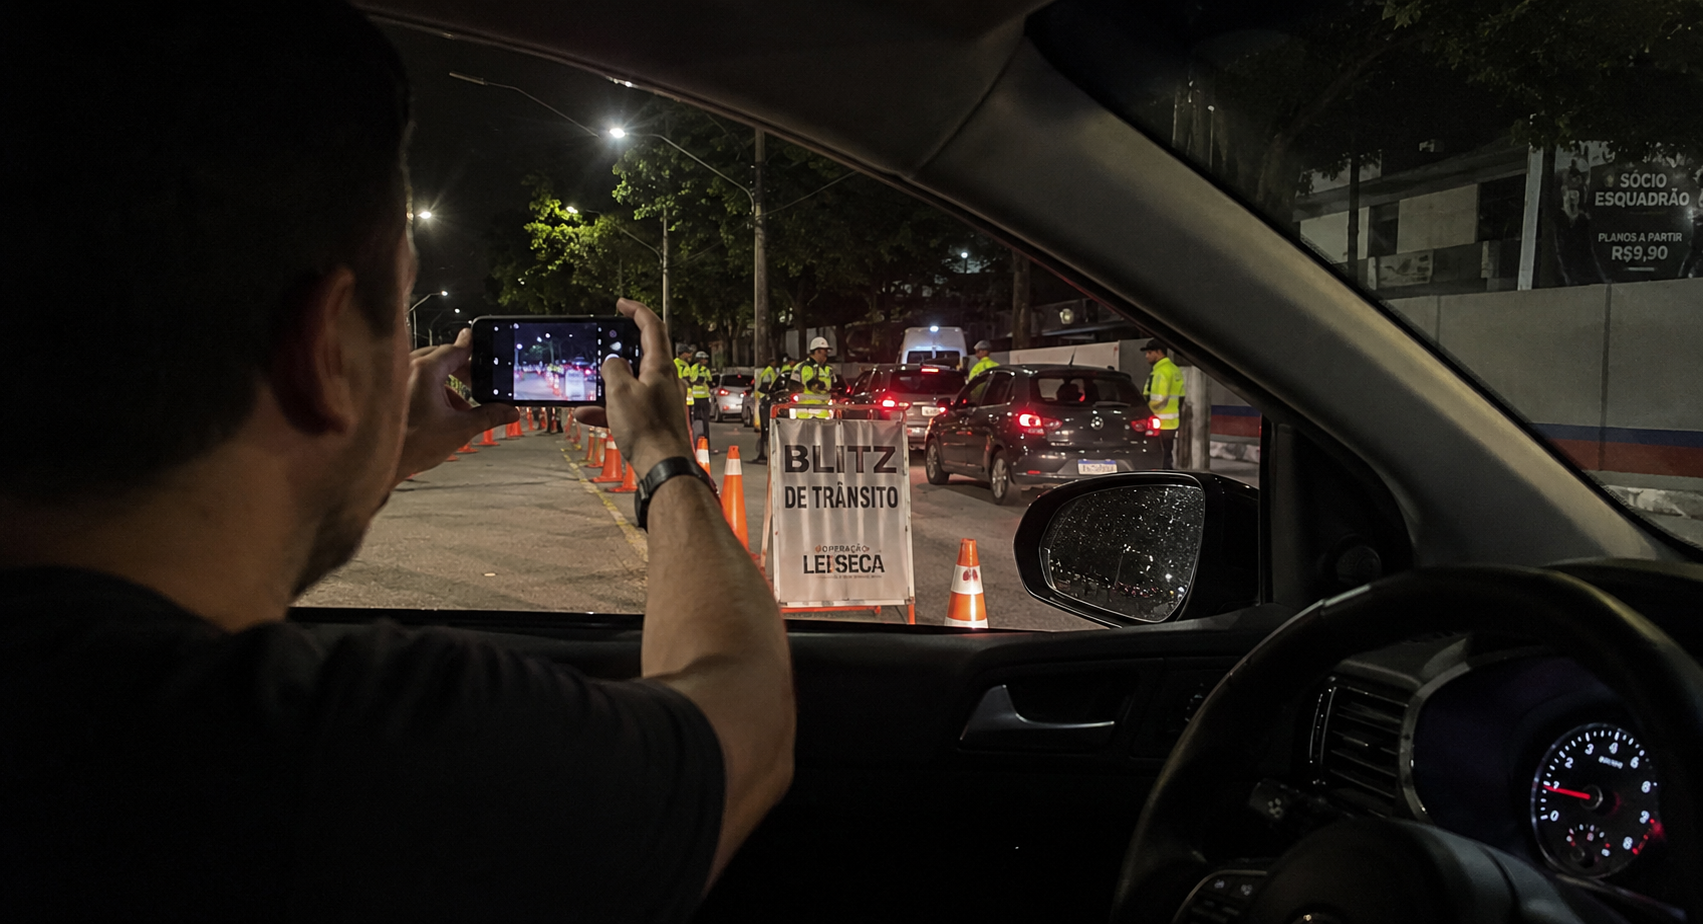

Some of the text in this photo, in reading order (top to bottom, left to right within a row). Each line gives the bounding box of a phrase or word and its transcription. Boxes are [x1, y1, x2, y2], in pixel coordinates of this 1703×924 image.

[1620, 169, 1667, 188] SÓCIO
[1595, 188, 1690, 207] ESQUADRÃO
[1598, 232, 1683, 242] PLANOS A PARTIR
[1611, 245, 1668, 263] R$9,90
[784, 444, 898, 474] BLITZ
[784, 481, 898, 509] DE TRÂNSITO
[822, 542, 867, 553] OPERAÇÃO
[803, 553, 885, 574] LEI SECA
[1584, 743, 1594, 755] 3
[1564, 756, 1573, 769] 2
[1550, 810, 1559, 821] 0
